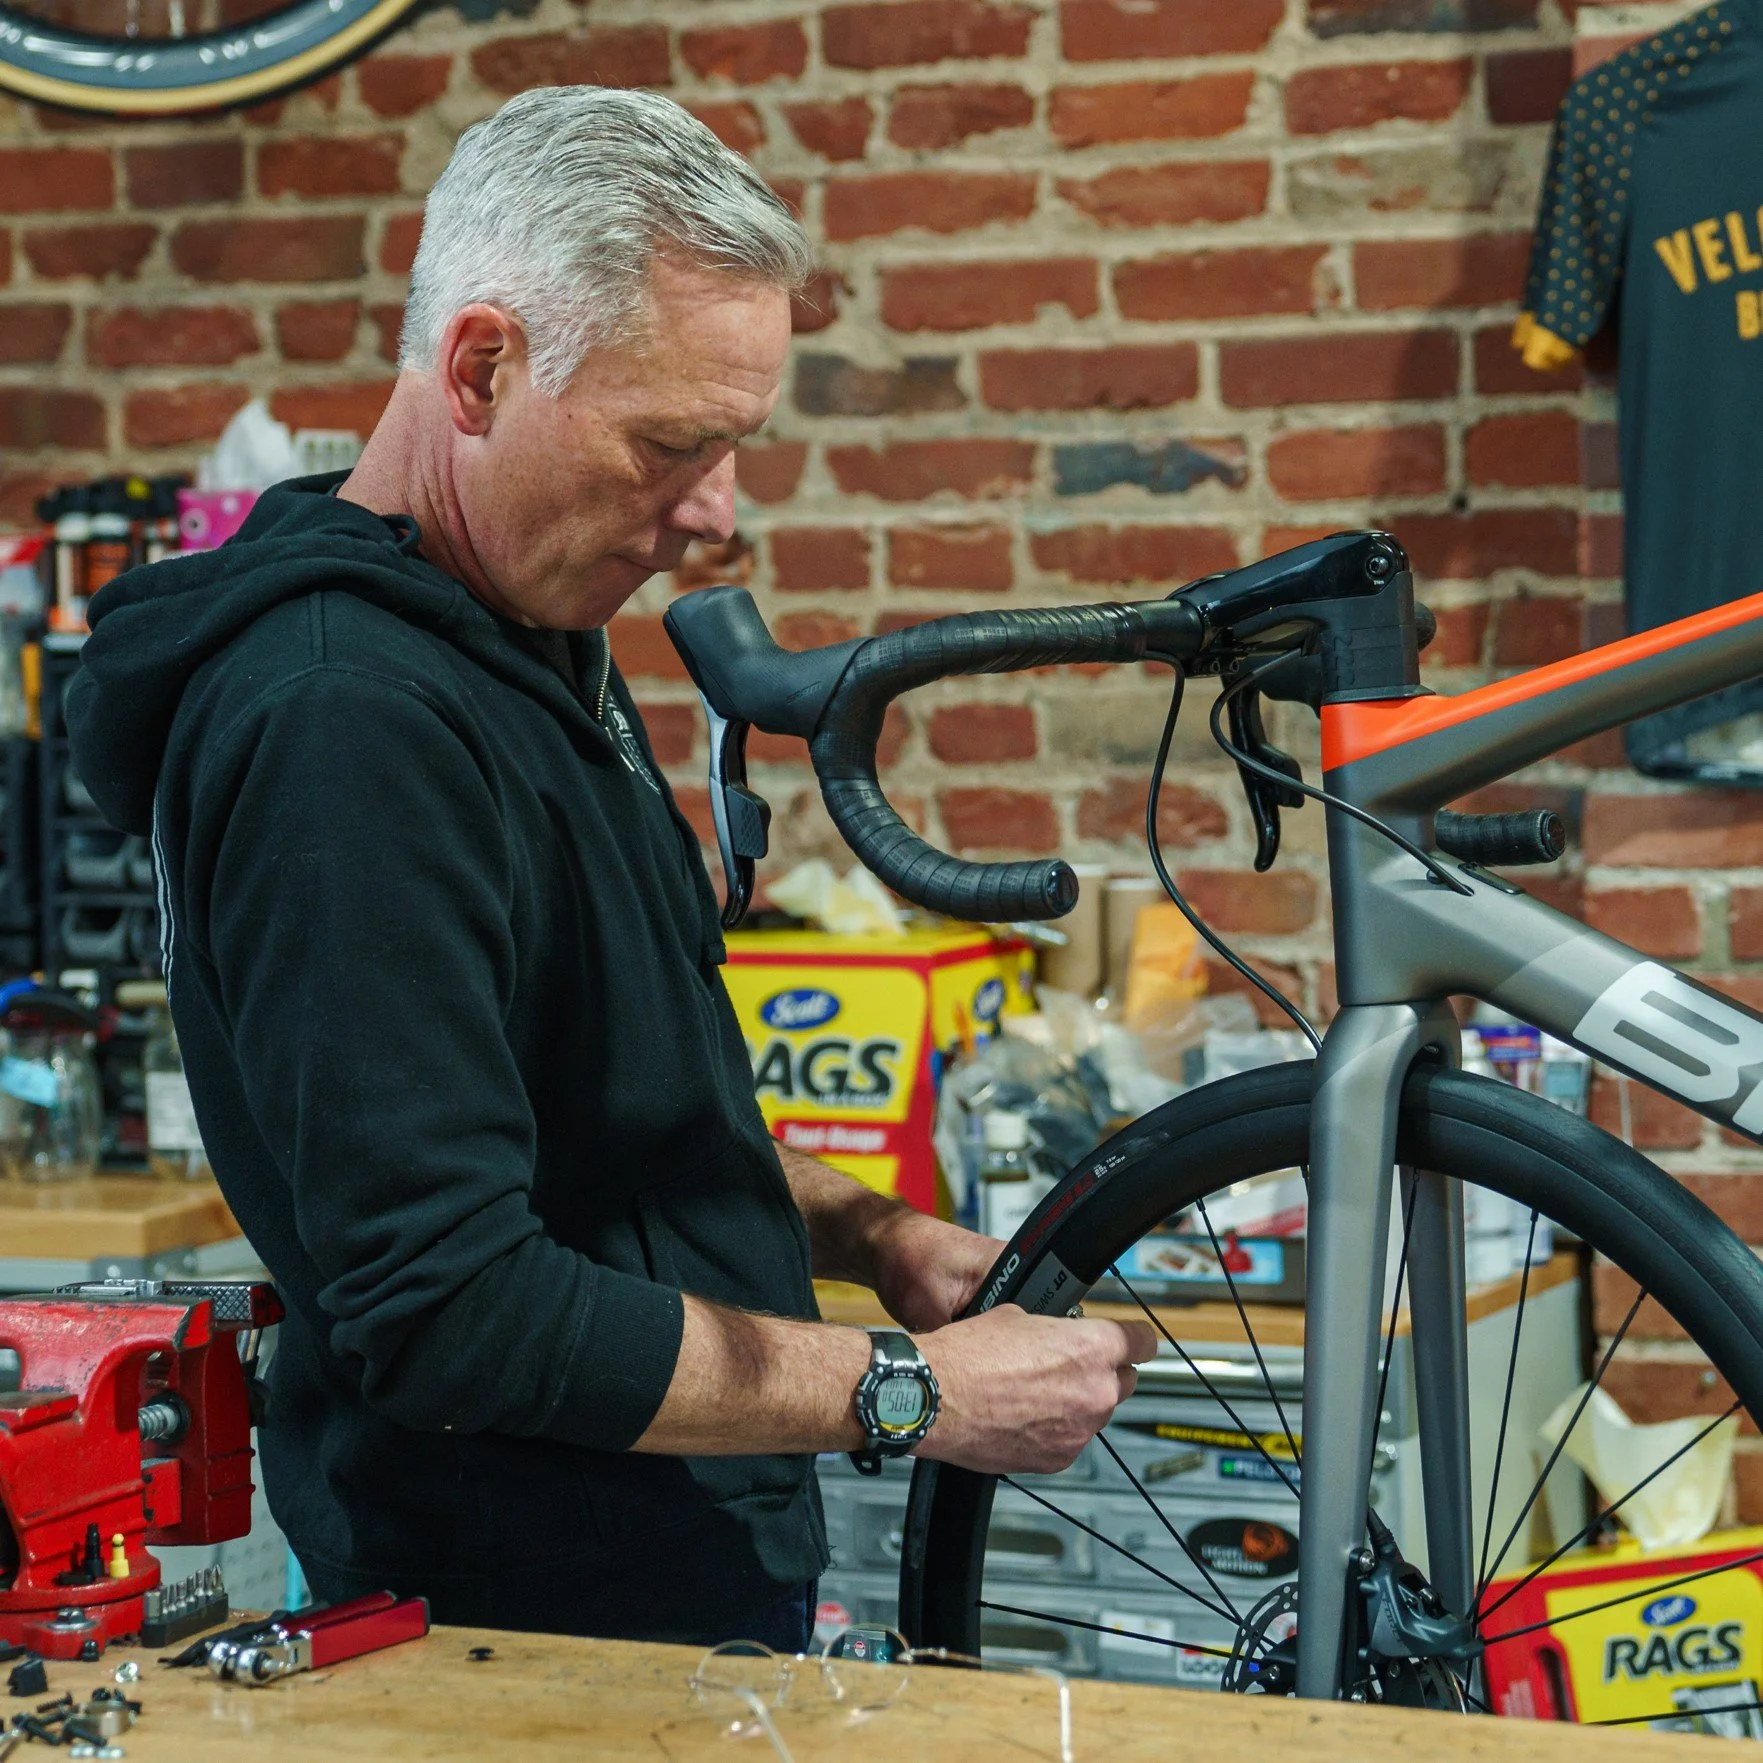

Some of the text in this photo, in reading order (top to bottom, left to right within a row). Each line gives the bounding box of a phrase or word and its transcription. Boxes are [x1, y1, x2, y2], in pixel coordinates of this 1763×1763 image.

[752, 1041, 898, 1098] AGS
[979, 1252, 1021, 1314] BINO
[1606, 1622, 1742, 1680] RAGS
